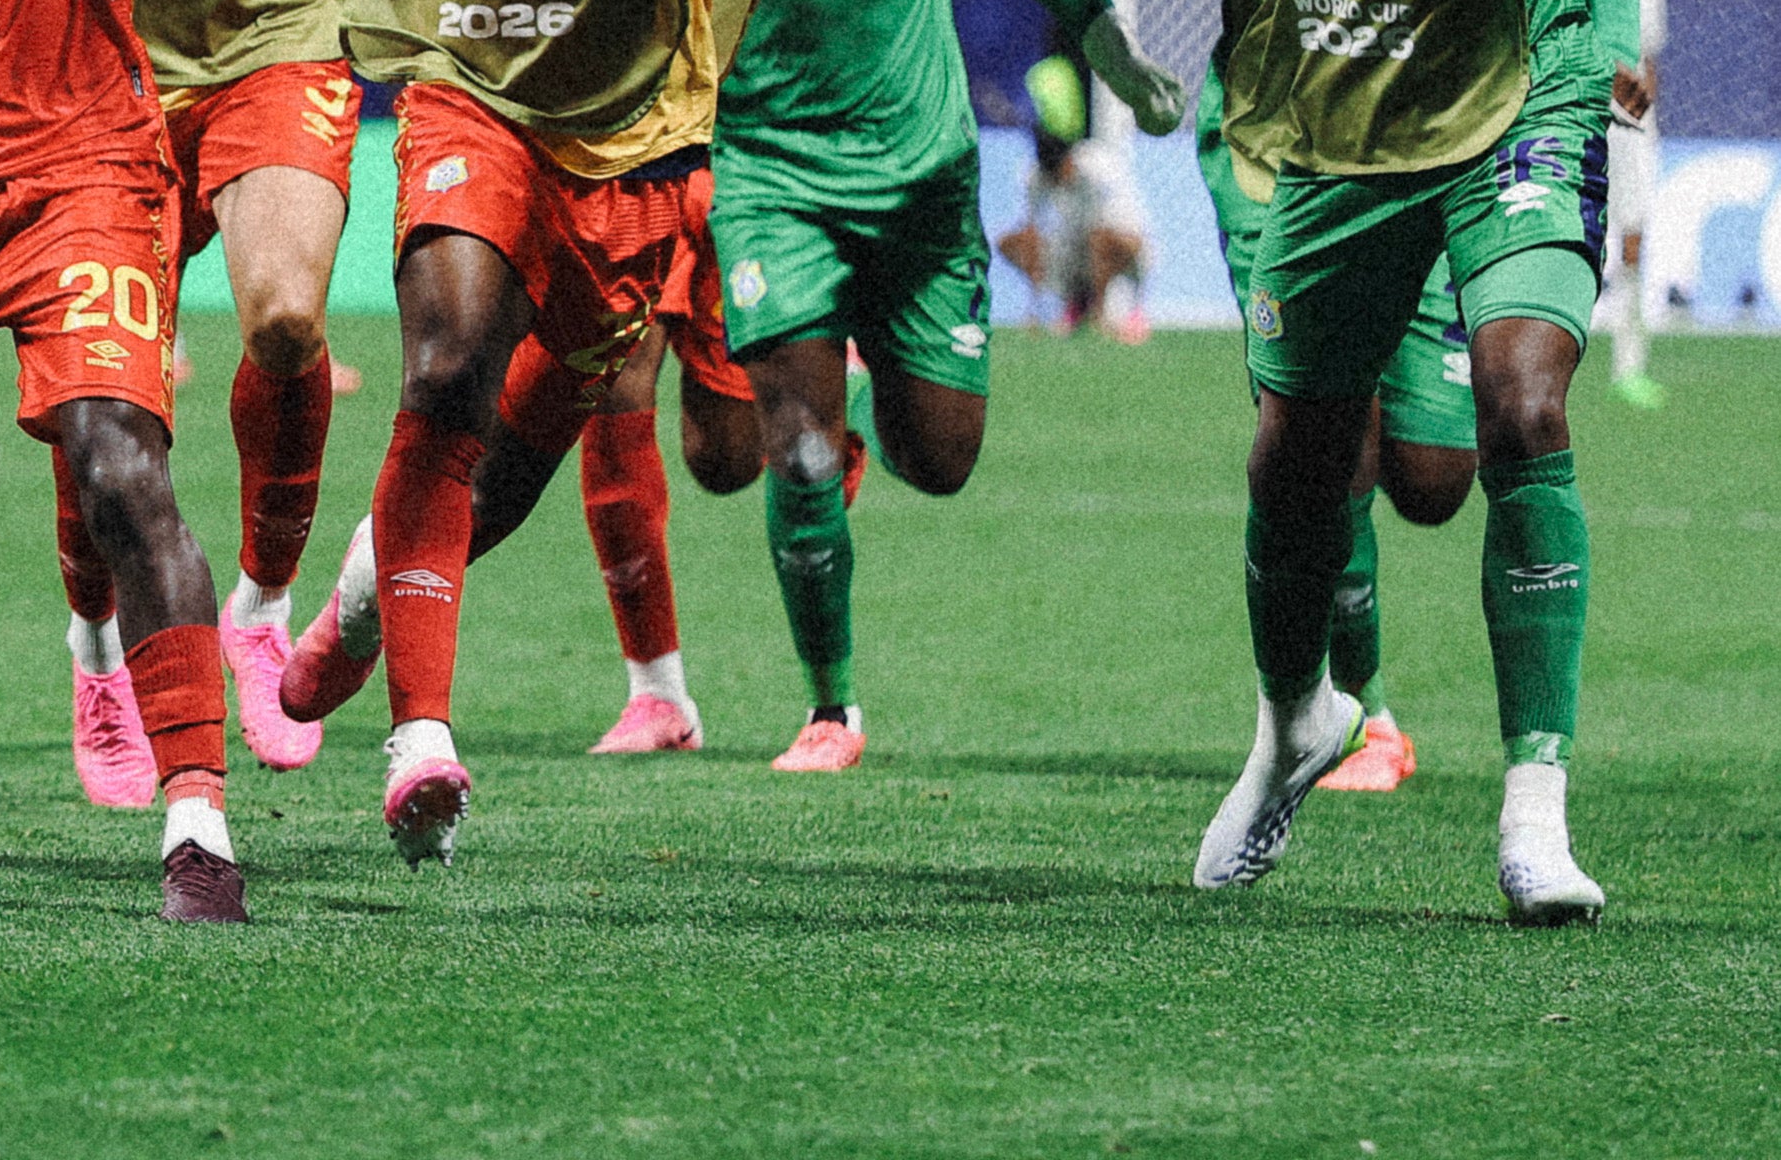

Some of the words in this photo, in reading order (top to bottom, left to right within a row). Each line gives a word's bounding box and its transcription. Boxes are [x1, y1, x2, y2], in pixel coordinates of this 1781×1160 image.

[438, 2, 575, 38] 2026
[1298, 18, 1416, 60] 2026
[58, 260, 159, 341] 20
[395, 586, 453, 603] umbro
[1512, 579, 1579, 593] umbro
